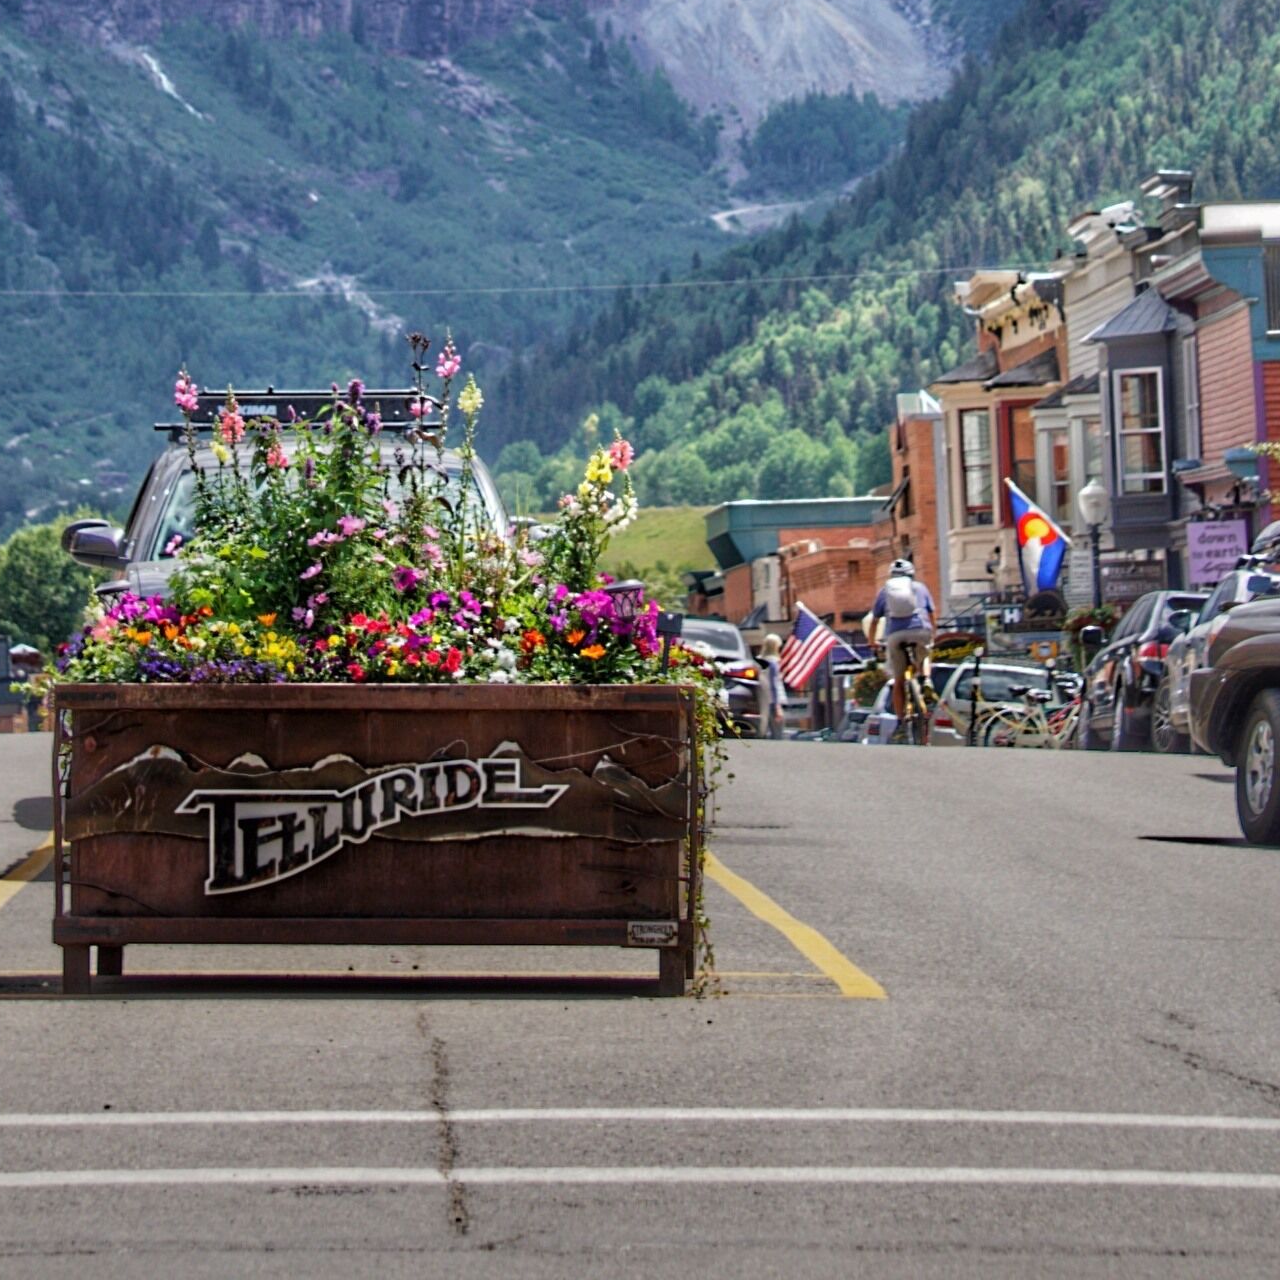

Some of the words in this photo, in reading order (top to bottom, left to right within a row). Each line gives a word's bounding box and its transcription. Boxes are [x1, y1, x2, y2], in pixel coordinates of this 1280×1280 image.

[217, 404, 278, 416] YKIMA
[1197, 532, 1238, 545] down
[1205, 545, 1244, 558] earth
[175, 757, 570, 896] TELLURIDE
